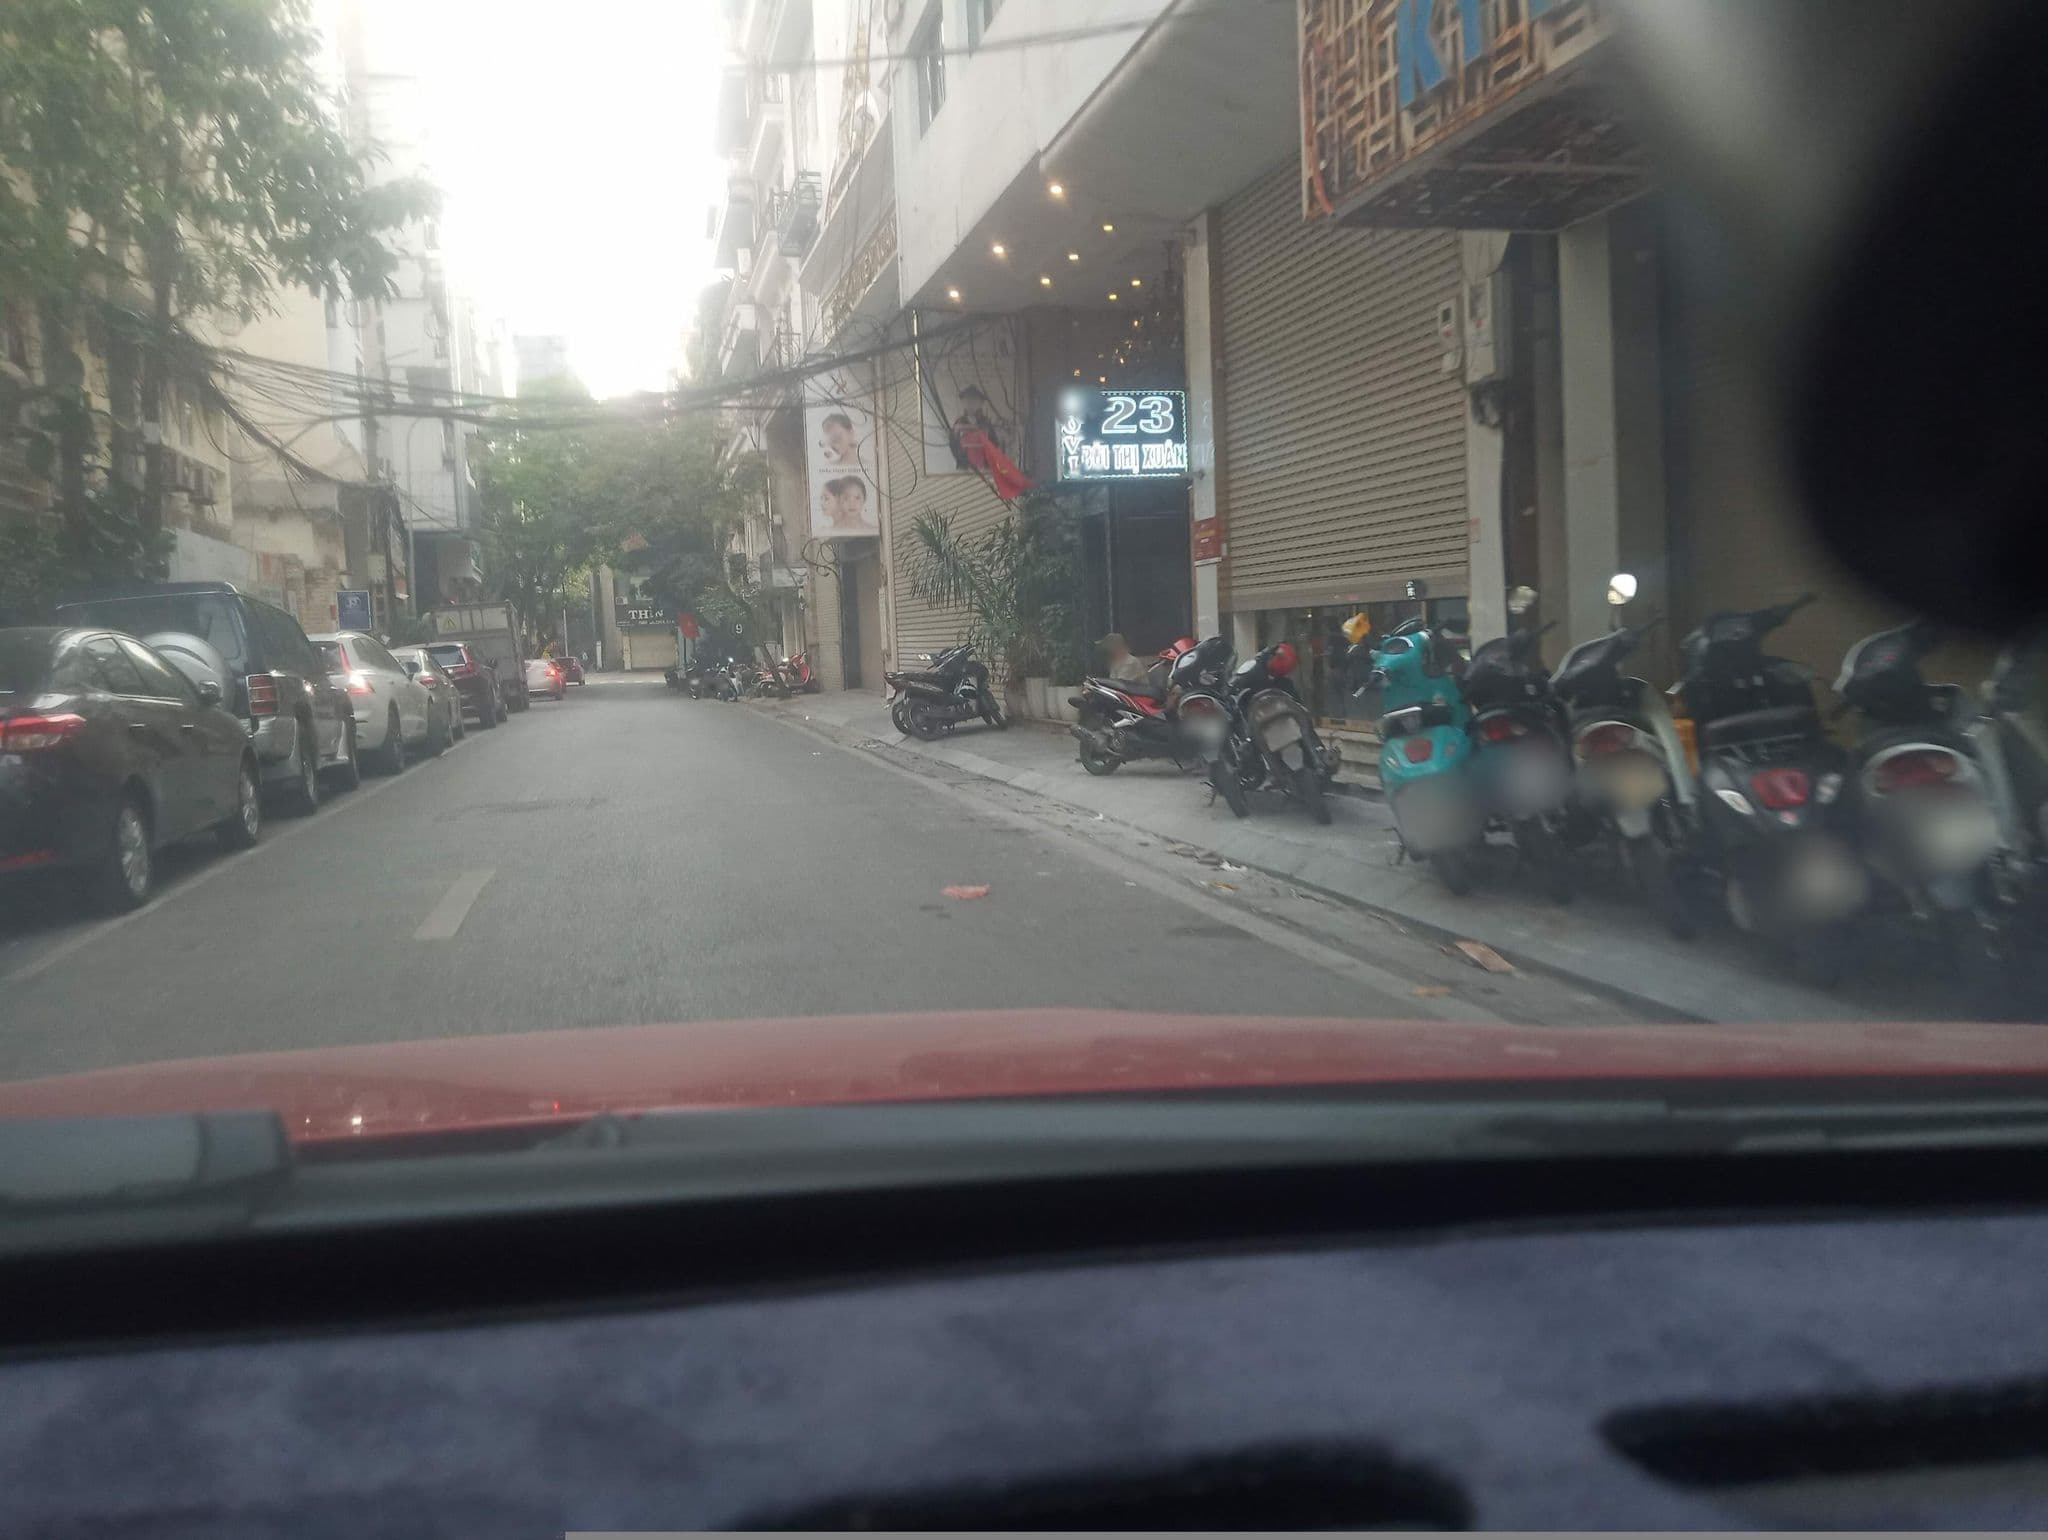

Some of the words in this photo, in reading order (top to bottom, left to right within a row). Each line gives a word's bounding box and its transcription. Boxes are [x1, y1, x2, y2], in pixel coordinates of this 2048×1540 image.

[1101, 396, 1175, 434] 23
[1141, 439, 1187, 469] XUÂN
[735, 623, 743, 634] 9
